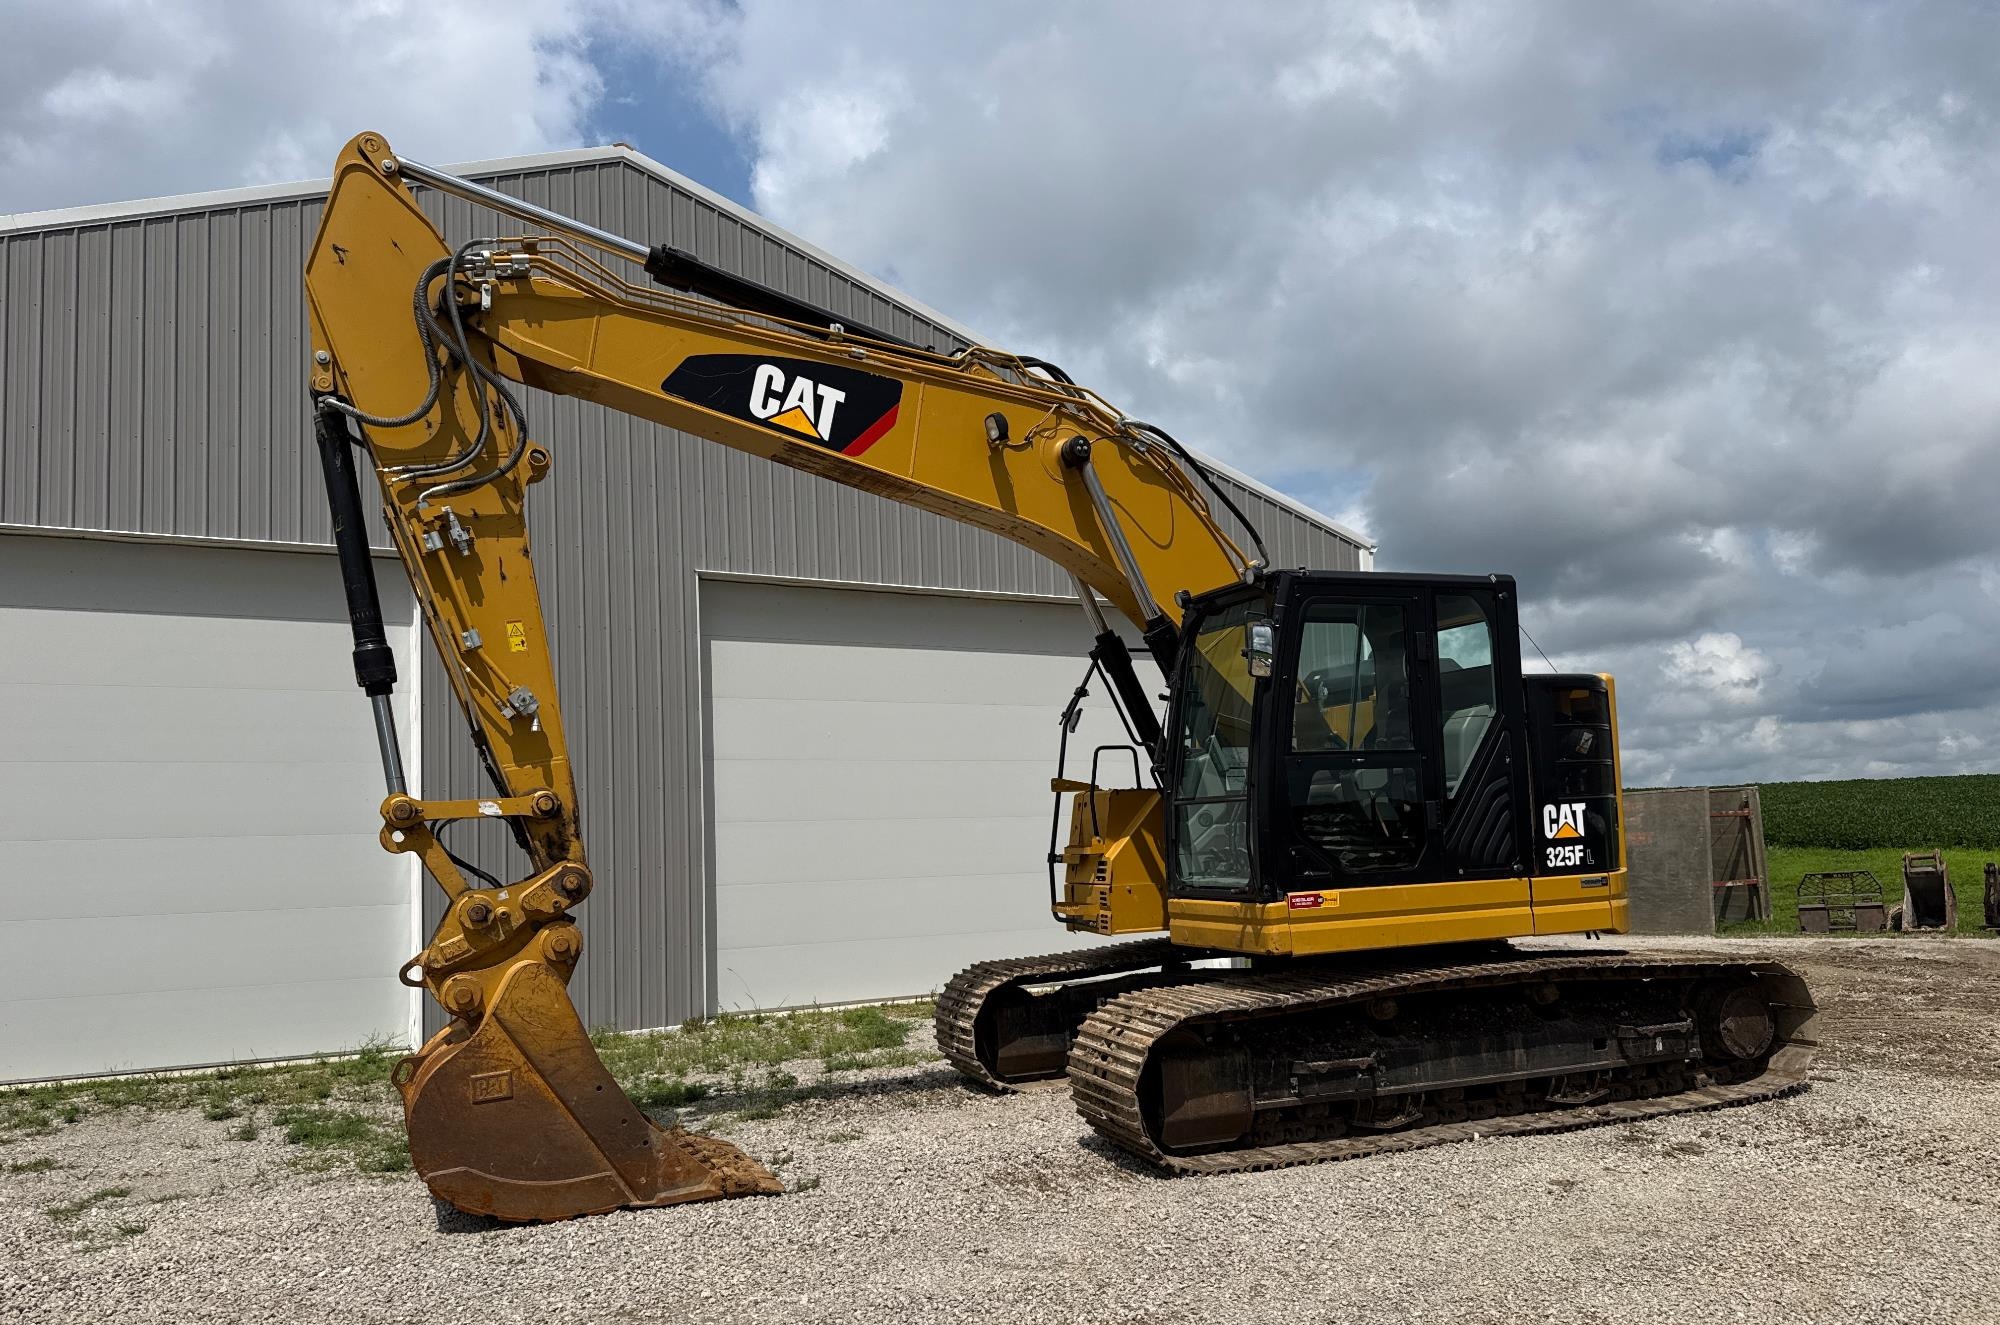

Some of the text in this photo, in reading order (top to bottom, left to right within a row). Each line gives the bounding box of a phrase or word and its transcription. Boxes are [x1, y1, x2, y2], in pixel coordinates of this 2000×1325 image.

[749, 363, 845, 442] CAT
[1543, 802, 1586, 839] CAT
[1546, 845, 1595, 868] 325F L
